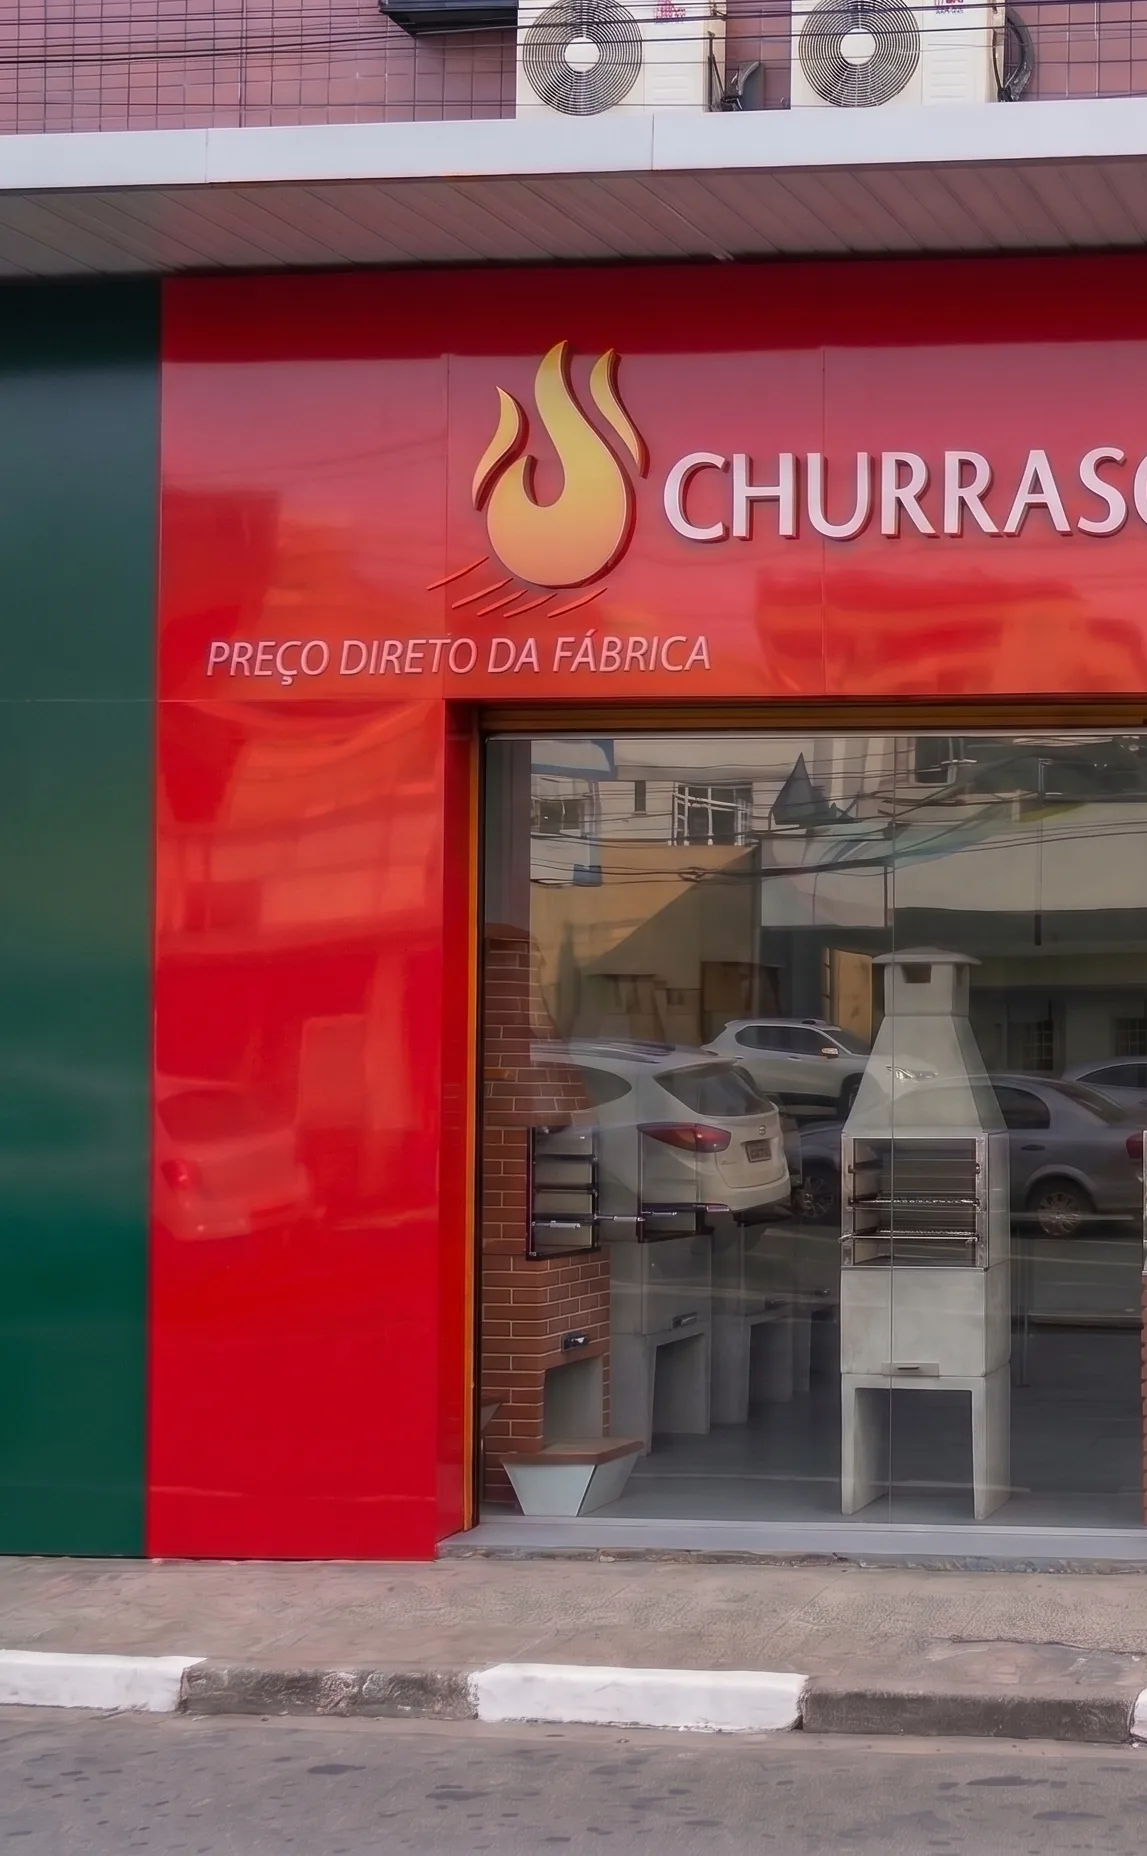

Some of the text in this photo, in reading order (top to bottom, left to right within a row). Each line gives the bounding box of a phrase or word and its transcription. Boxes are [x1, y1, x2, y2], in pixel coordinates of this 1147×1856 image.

[206, 629, 712, 684] PREÇO DIRETO DA FÁBRICA
